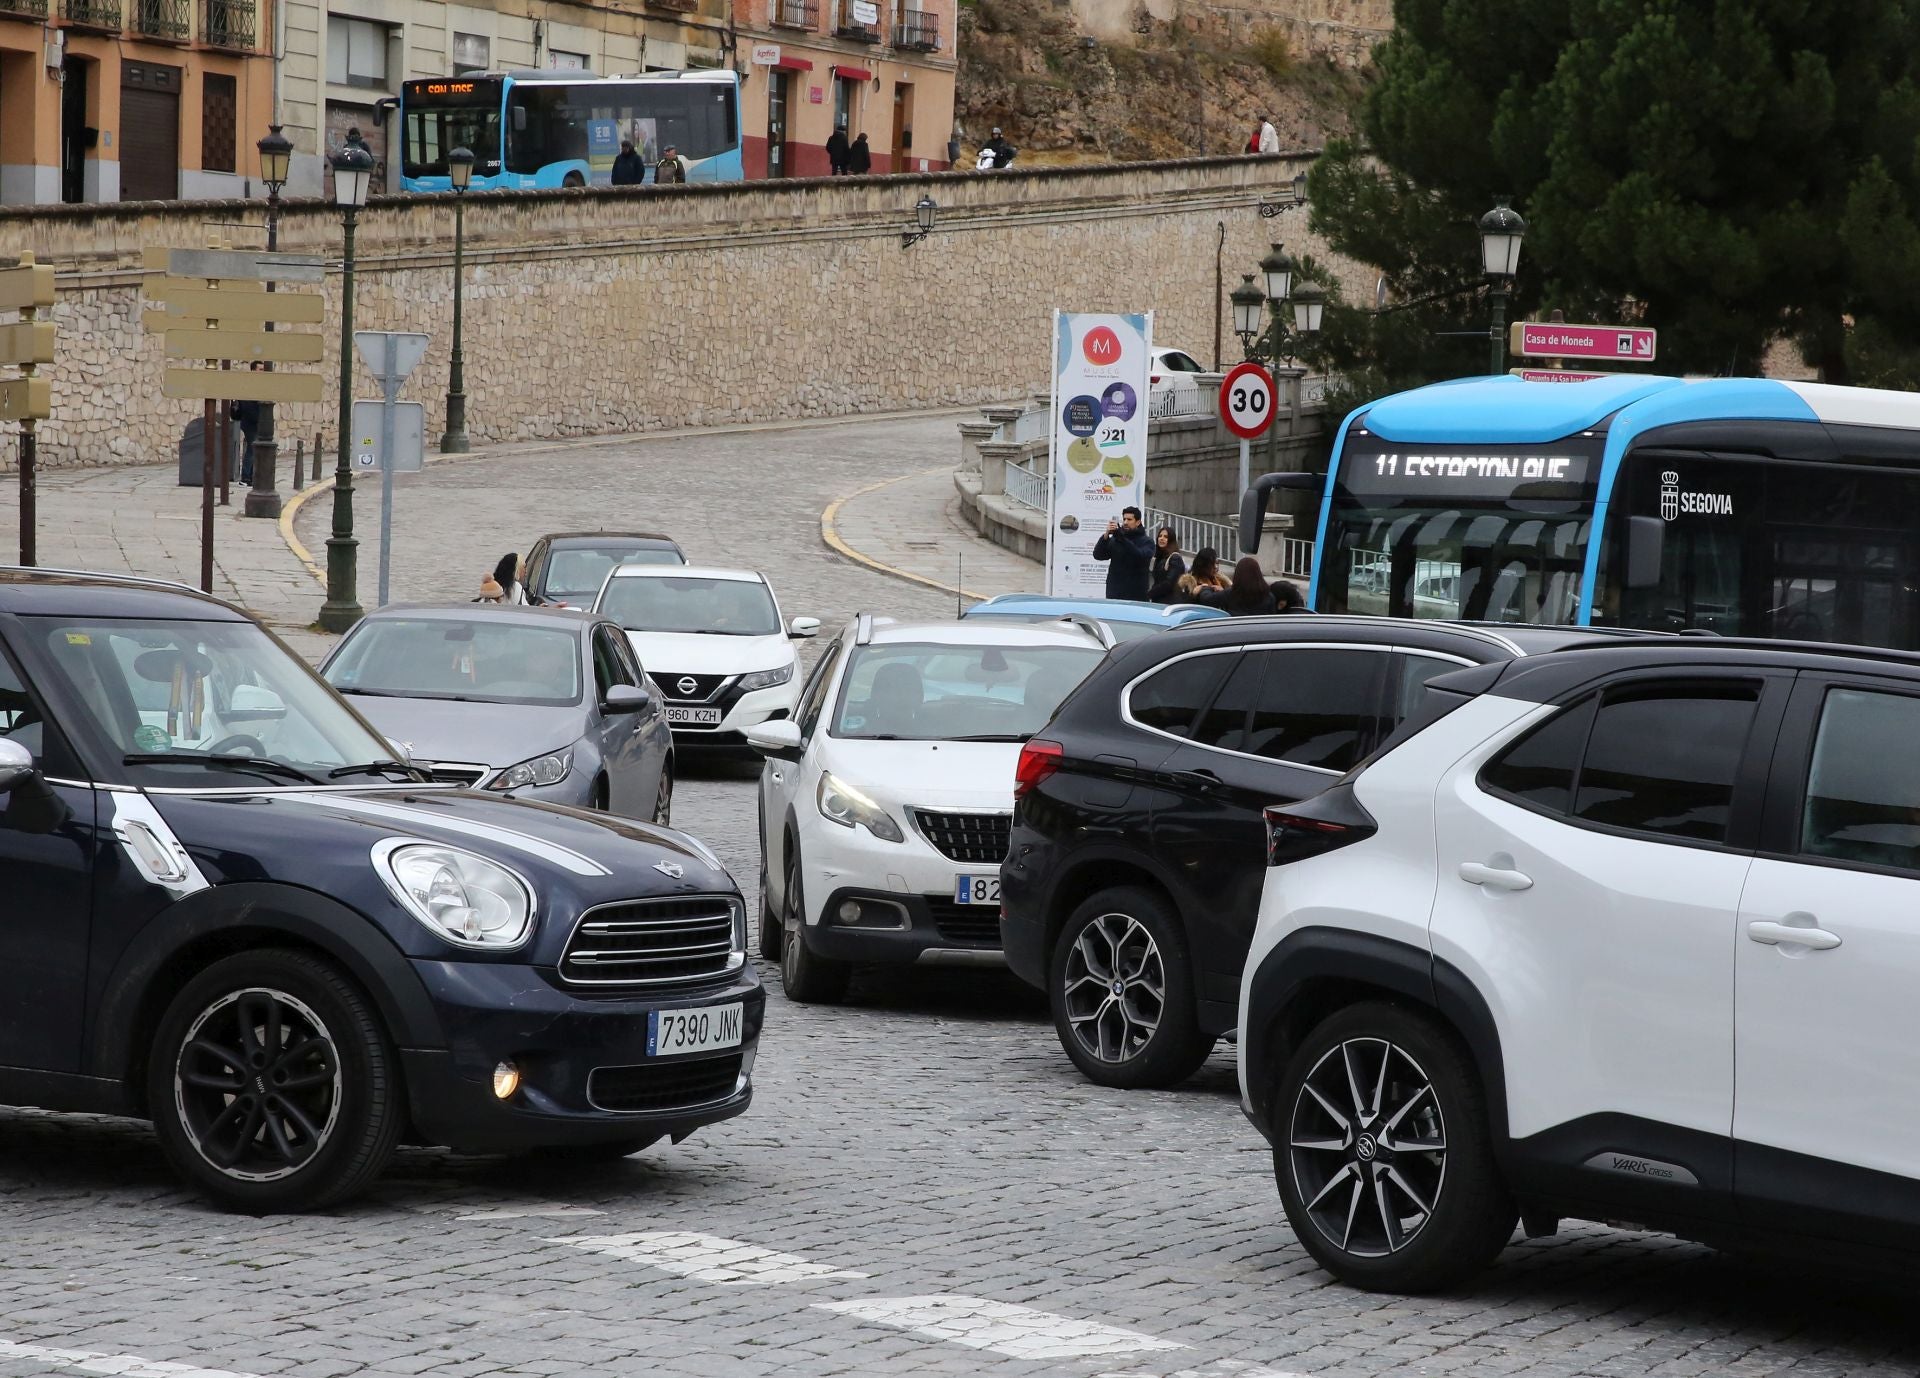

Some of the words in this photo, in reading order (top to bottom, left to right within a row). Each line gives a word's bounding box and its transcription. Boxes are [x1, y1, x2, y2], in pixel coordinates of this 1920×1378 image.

[415, 85, 420, 94] 1
[1526, 333, 1546, 345] Casa
[1548, 334, 1559, 345] de
[1561, 335, 1594, 347] Moneda
[1233, 388, 1266, 414] 30
[1376, 454, 1398, 476] 11
[1680, 491, 1733, 515] SEGOVIA
[694, 710, 717, 722] KZH
[661, 1013, 709, 1049] 7390
[713, 1007, 741, 1042] JNK
[1613, 1157, 1650, 1174] YARIS
[1648, 1167, 1674, 1178] CROSS
